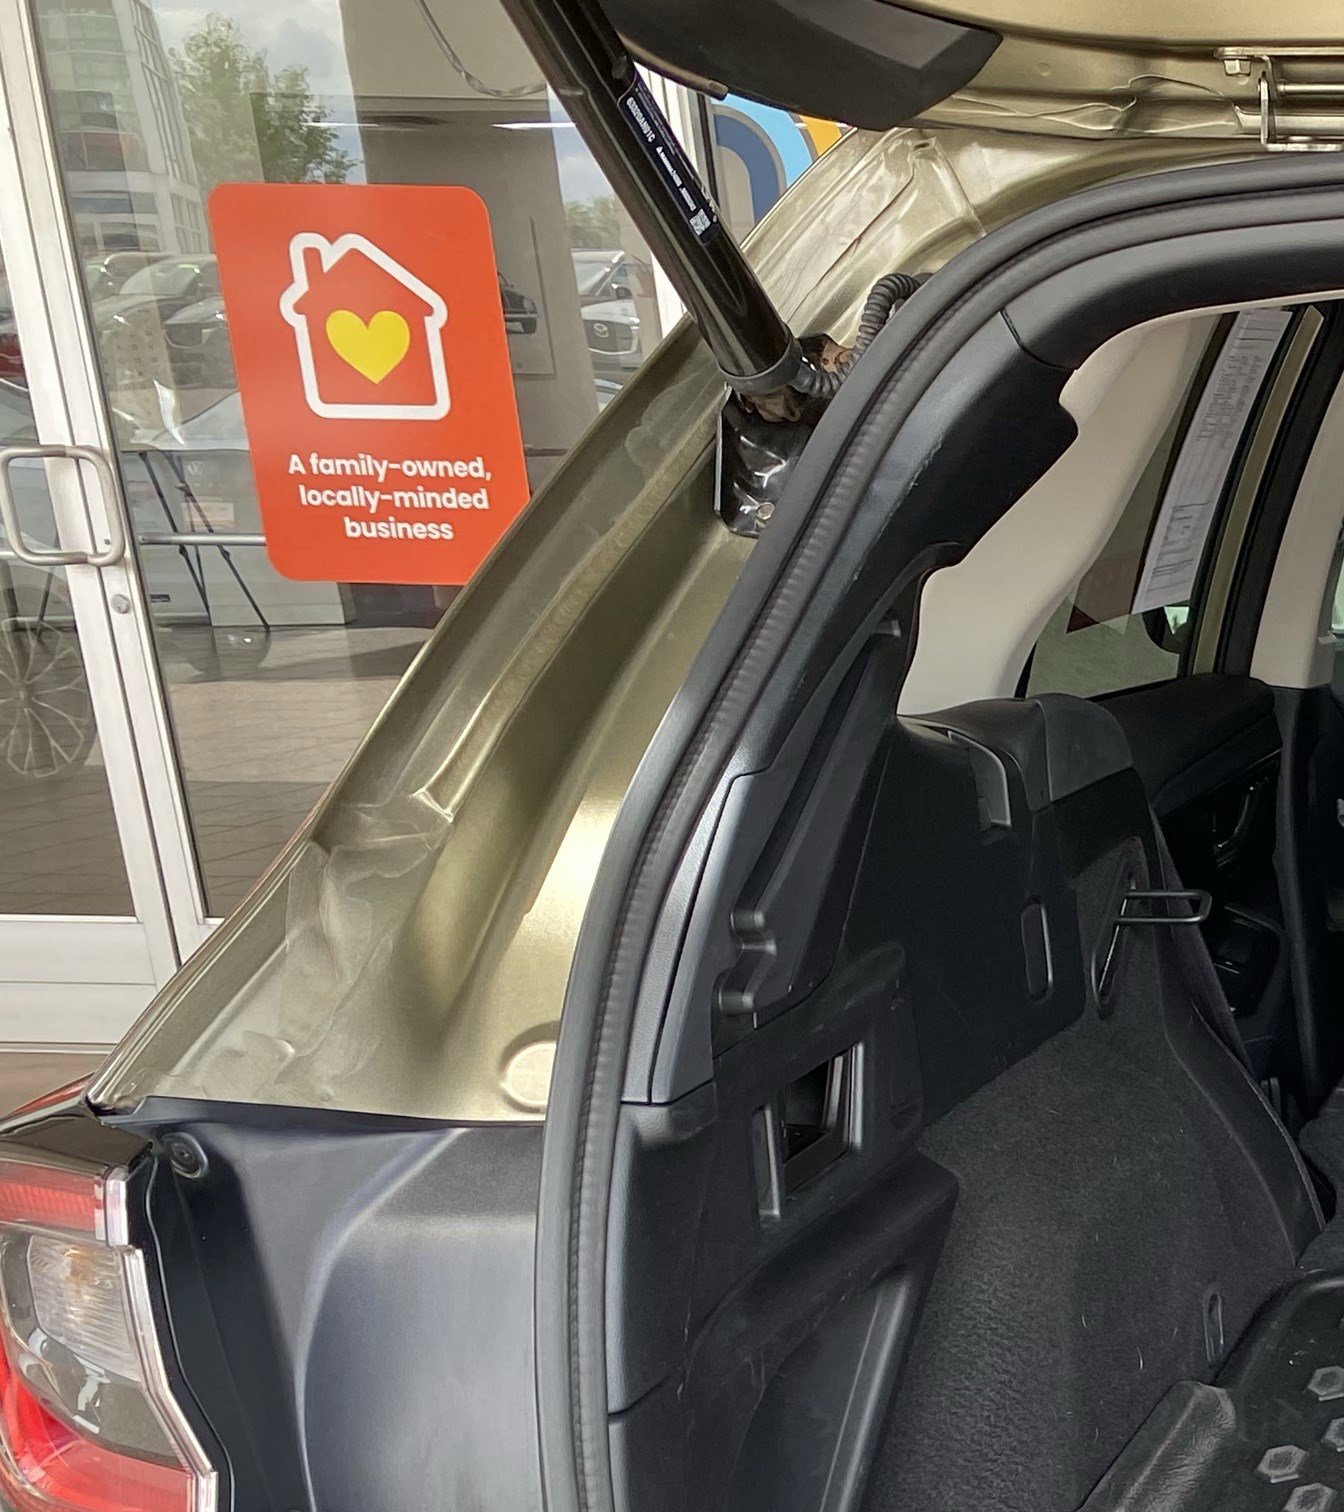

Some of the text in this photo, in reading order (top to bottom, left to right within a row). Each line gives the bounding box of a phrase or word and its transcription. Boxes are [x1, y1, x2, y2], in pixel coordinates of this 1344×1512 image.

[288, 452, 491, 482] A family-owned,
[299, 485, 489, 514] locally-minded
[344, 516, 454, 540] business
